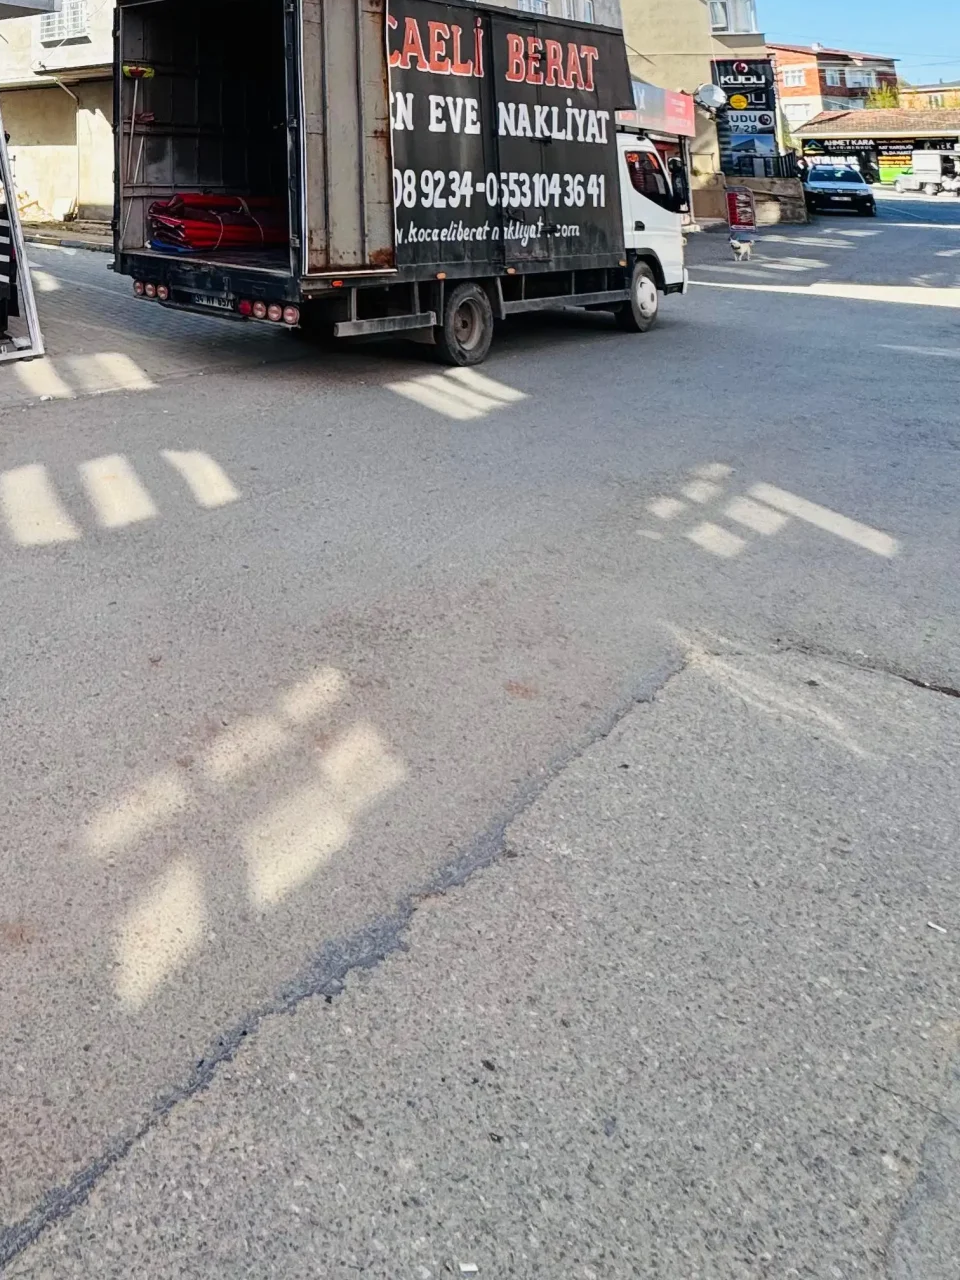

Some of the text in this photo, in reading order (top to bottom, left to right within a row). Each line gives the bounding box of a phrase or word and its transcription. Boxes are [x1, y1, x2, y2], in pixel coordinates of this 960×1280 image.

[505, 33, 599, 92] BERAT
[720, 74, 766, 85] KUDU
[390, 91, 610, 144] N EVE NAKLİYAT
[726, 114, 757, 123] UDU
[824, 139, 851, 147] AHMET
